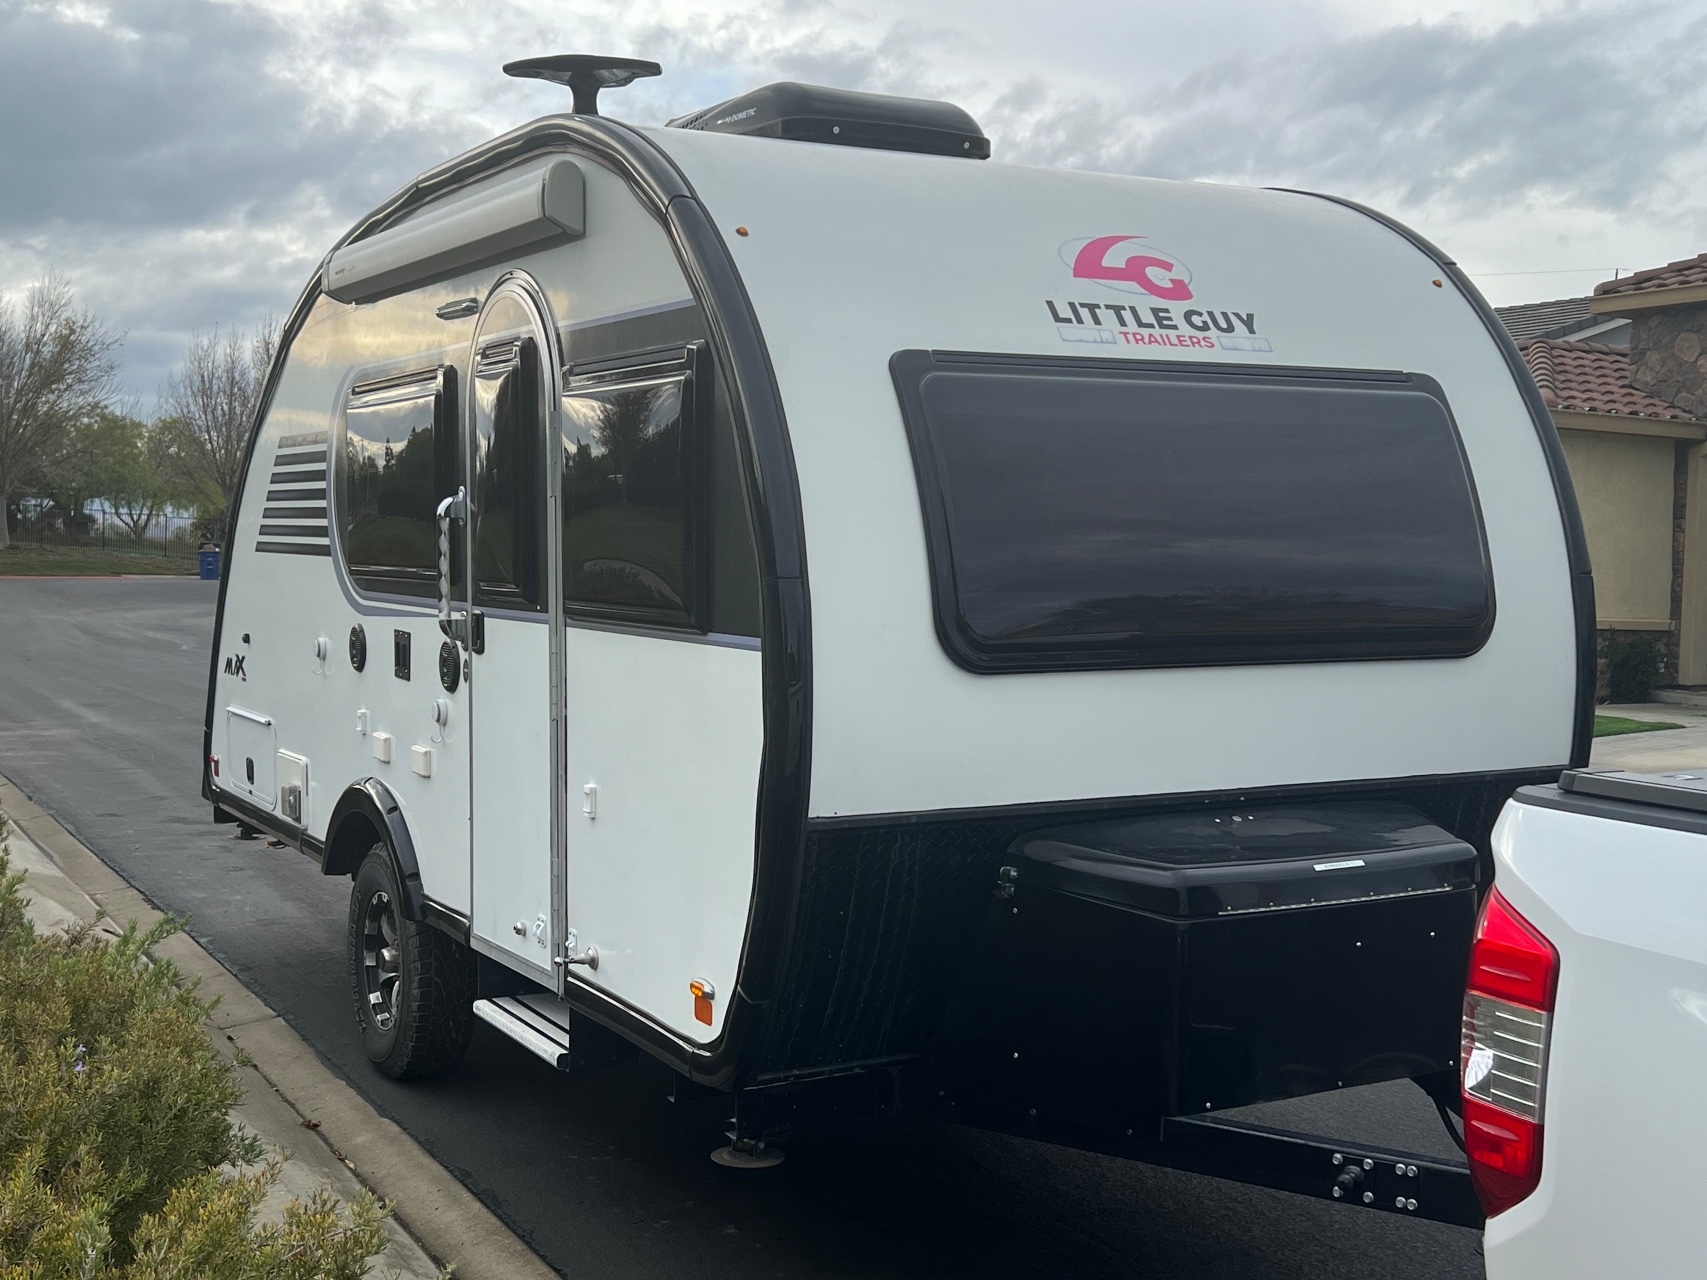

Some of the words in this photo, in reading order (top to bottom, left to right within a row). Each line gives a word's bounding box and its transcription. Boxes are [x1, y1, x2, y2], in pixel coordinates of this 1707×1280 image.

[731, 107, 757, 123] DOMETIC
[1045, 300, 1179, 331] LITTLE
[1183, 309, 1257, 335] GUY
[1119, 331, 1215, 349] TRAILERS
